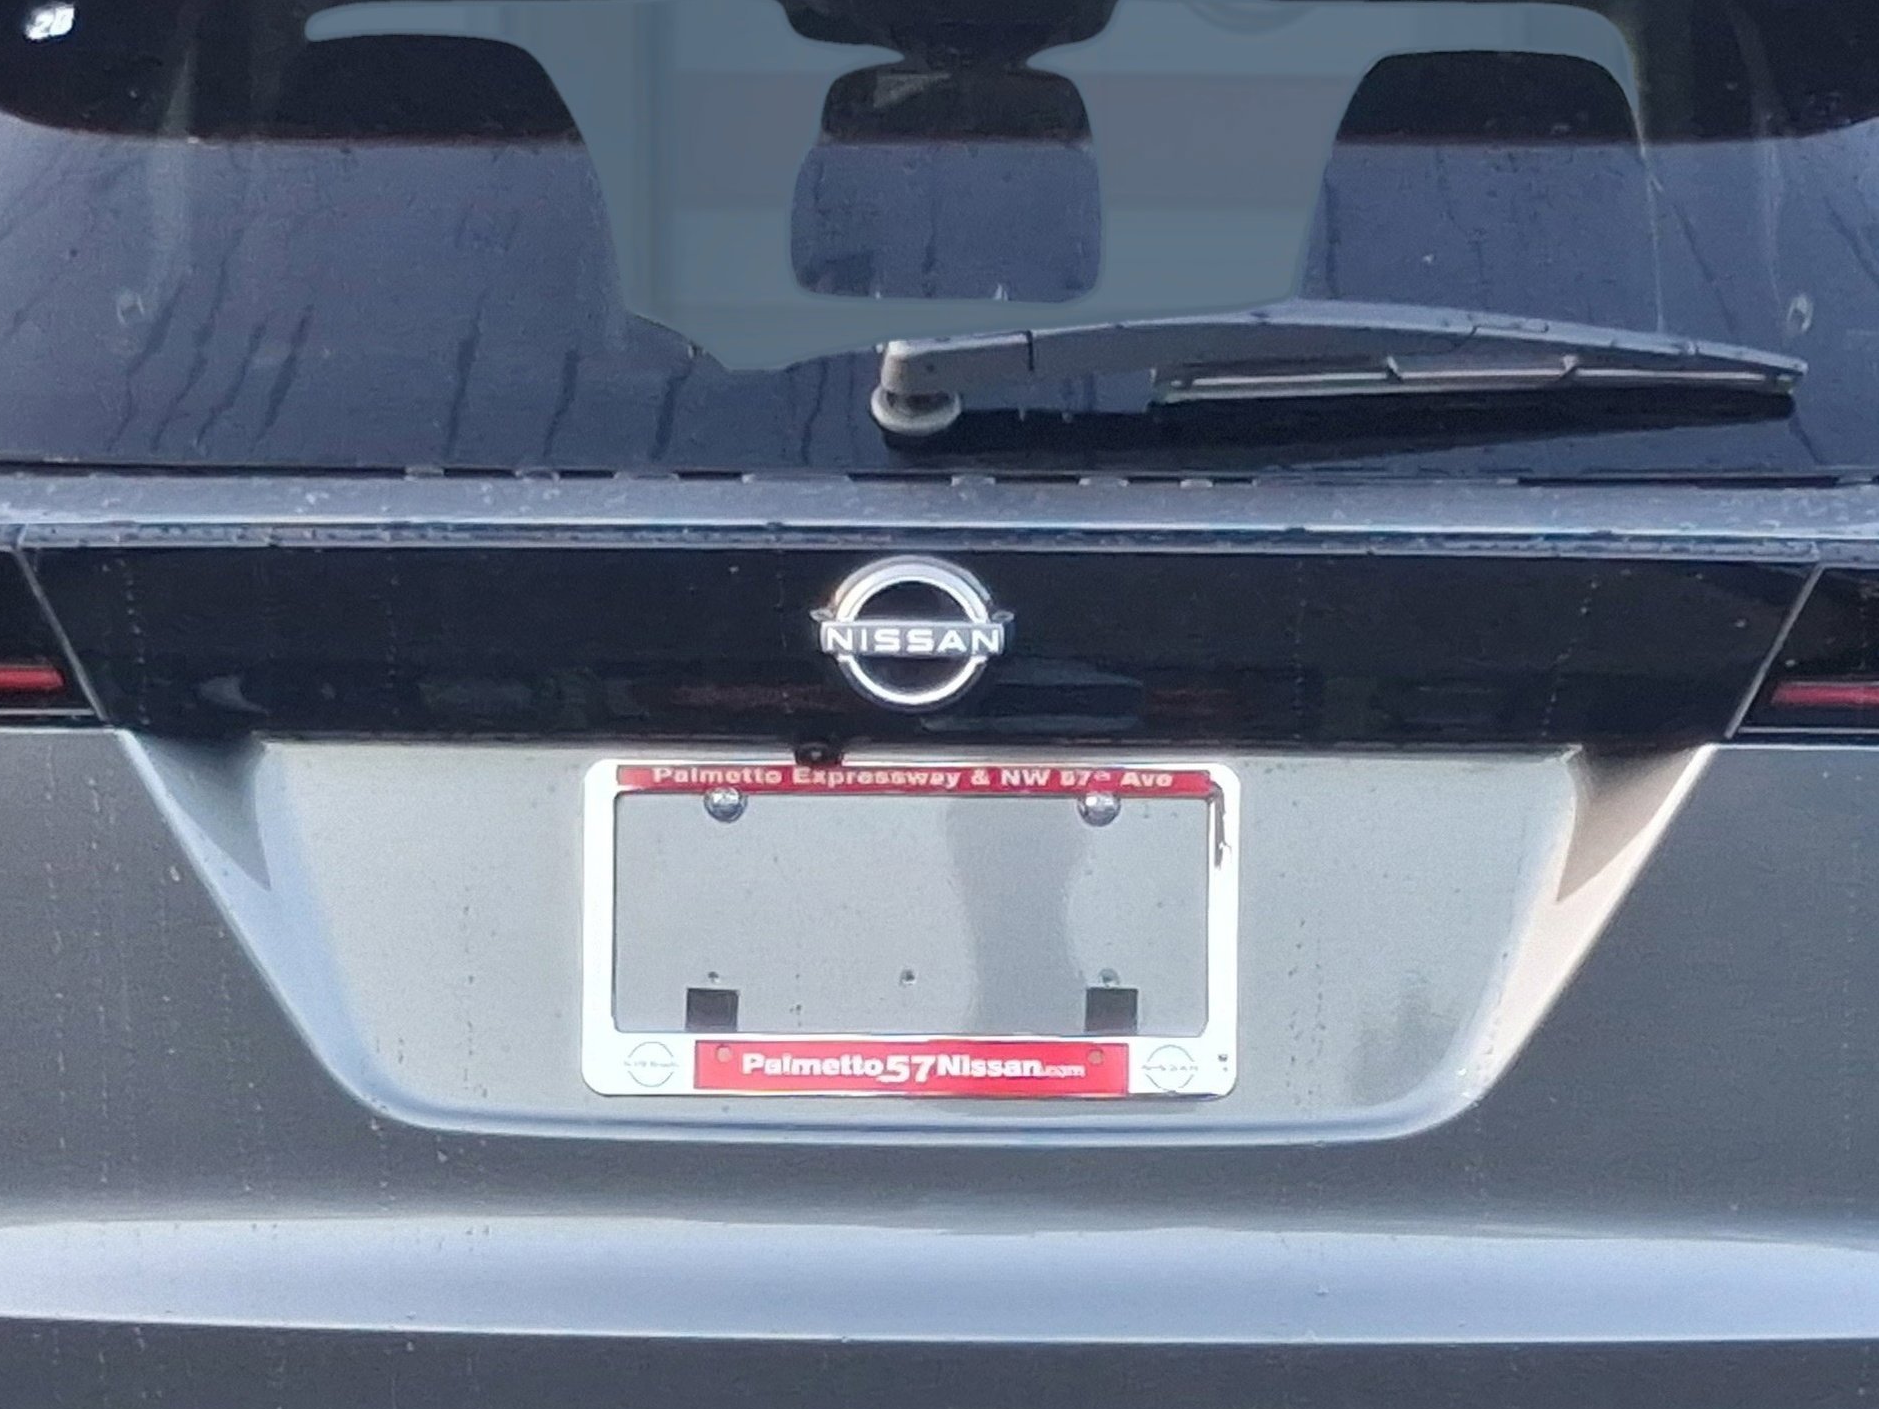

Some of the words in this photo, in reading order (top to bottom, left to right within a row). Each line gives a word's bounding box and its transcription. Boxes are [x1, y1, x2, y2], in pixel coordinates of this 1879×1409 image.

[826, 627, 999, 653] NISSAN
[653, 766, 782, 785] Palmetto
[792, 766, 961, 789] Expressway
[971, 768, 991, 786] &
[1001, 769, 1051, 787] NW
[1122, 772, 1174, 788] Ave
